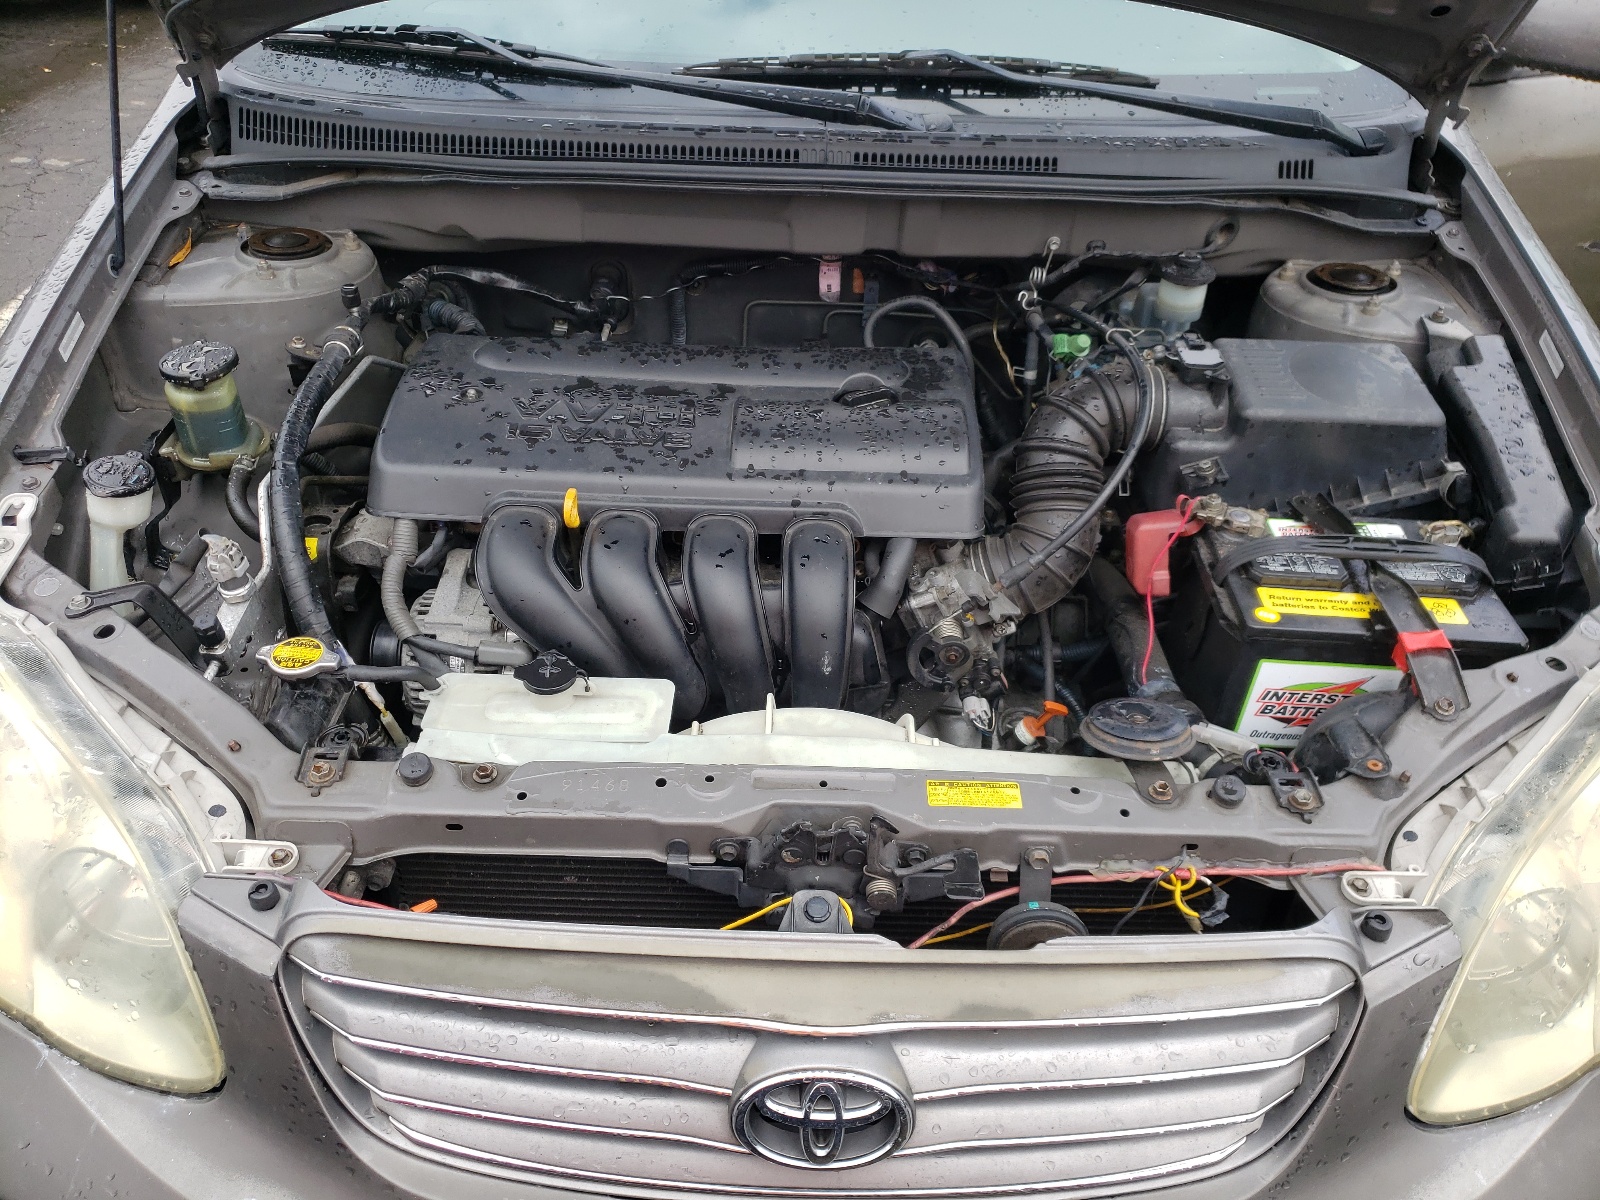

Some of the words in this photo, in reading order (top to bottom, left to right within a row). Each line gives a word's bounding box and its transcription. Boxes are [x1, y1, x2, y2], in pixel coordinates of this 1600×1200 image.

[558, 424, 692, 447] VALVE
[1268, 594, 1302, 602] Return
[1305, 597, 1348, 606] warranty
[1272, 601, 1316, 610] batteries
[1331, 605, 1366, 613] Costco
[275, 656, 310, 664] CAUTION
[562, 779, 629, 792] 91468
